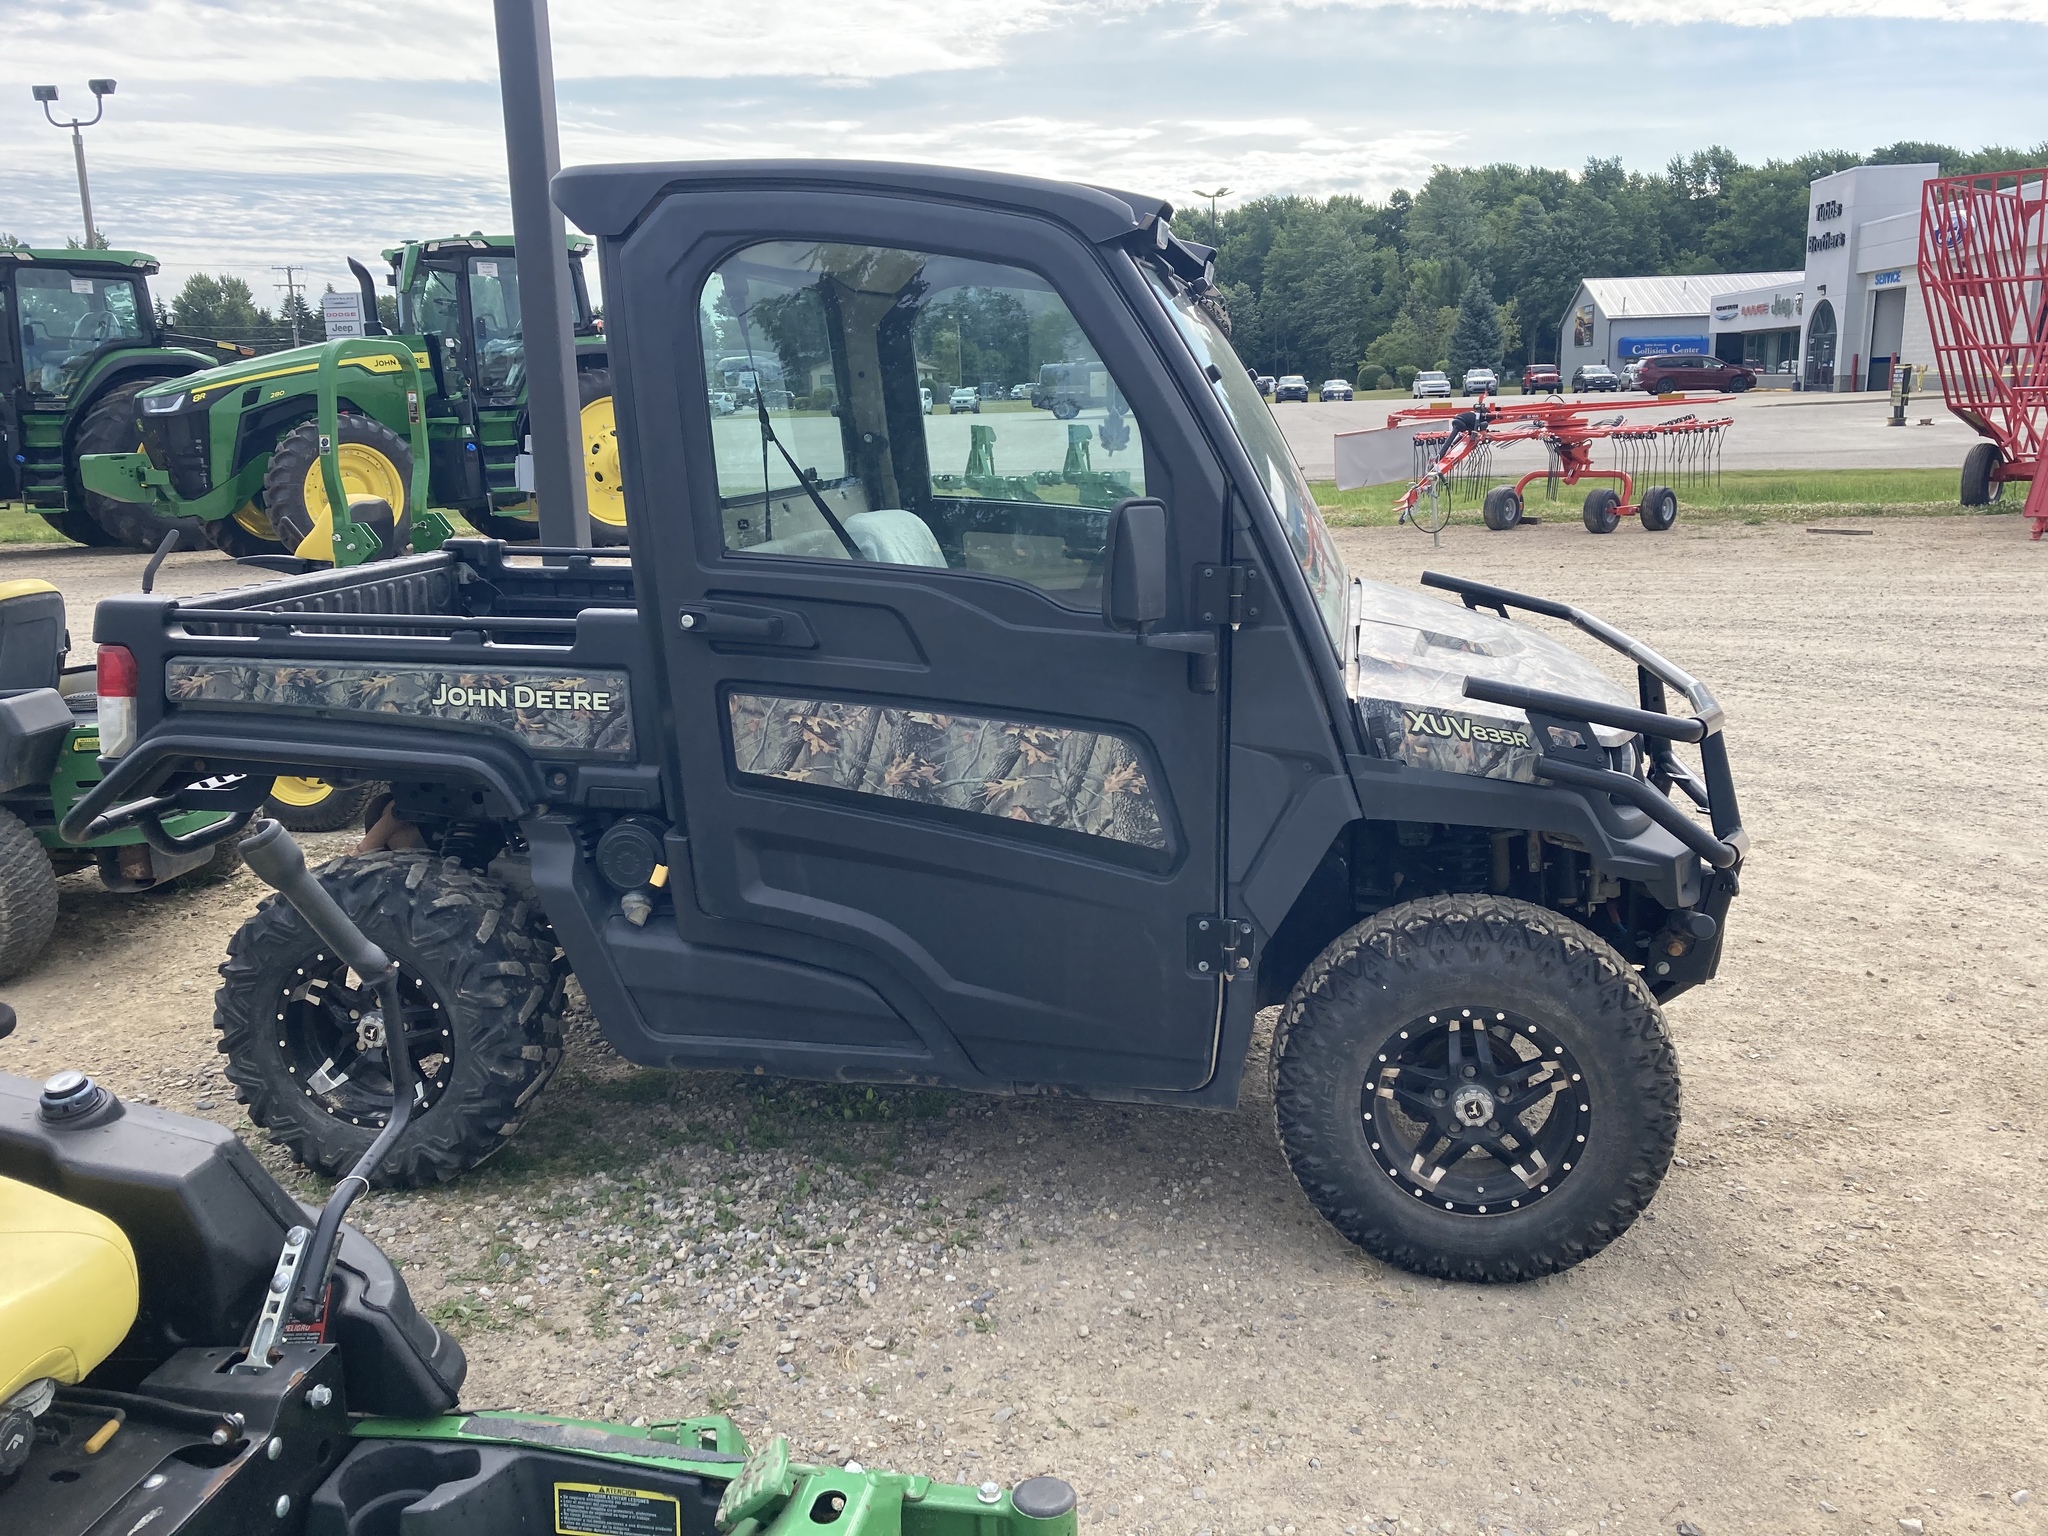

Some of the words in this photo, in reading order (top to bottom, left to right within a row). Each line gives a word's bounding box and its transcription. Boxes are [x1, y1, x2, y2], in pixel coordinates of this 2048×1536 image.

[1815, 200, 1843, 222] Tubbs
[1808, 231, 1846, 253] Brothers
[1874, 270, 1901, 286] SERVICE
[332, 323, 354, 333] Jeep
[1632, 344, 1668, 355] Collision
[1671, 343, 1700, 354] Center
[375, 359, 397, 367] JOHN
[192, 392, 206, 403] 8R
[269, 390, 285, 399] 280
[432, 683, 507, 708] JOHN
[513, 684, 611, 711] DEERE
